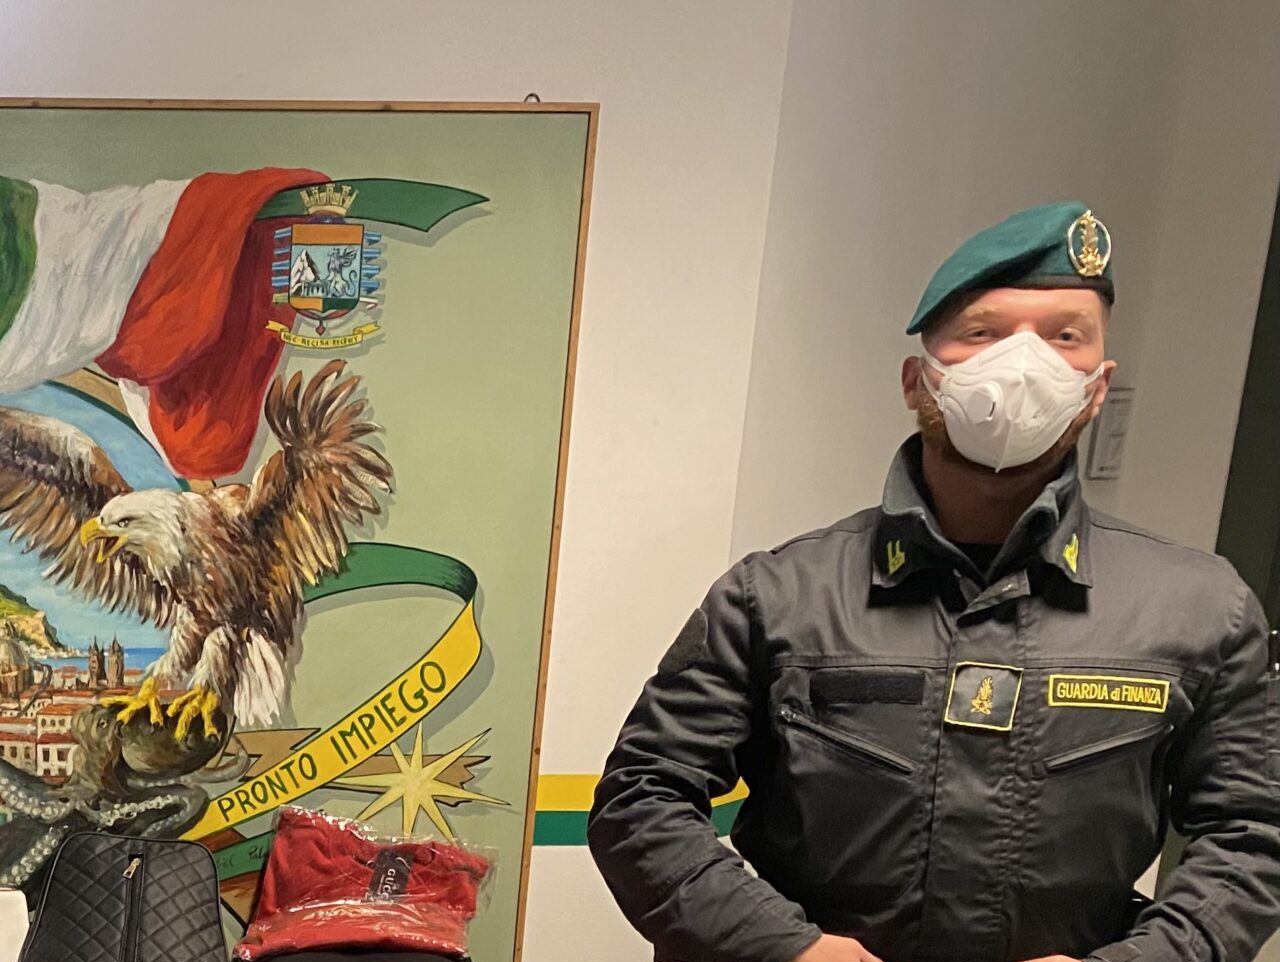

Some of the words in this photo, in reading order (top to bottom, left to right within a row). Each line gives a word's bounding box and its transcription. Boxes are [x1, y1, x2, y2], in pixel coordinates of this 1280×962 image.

[1056, 682, 1109, 700] GUARDIA
[1110, 688, 1120, 701] di
[1121, 686, 1162, 705] FINANZA
[217, 752, 318, 822] PRONTO
[330, 661, 447, 765] IMPIEGO
